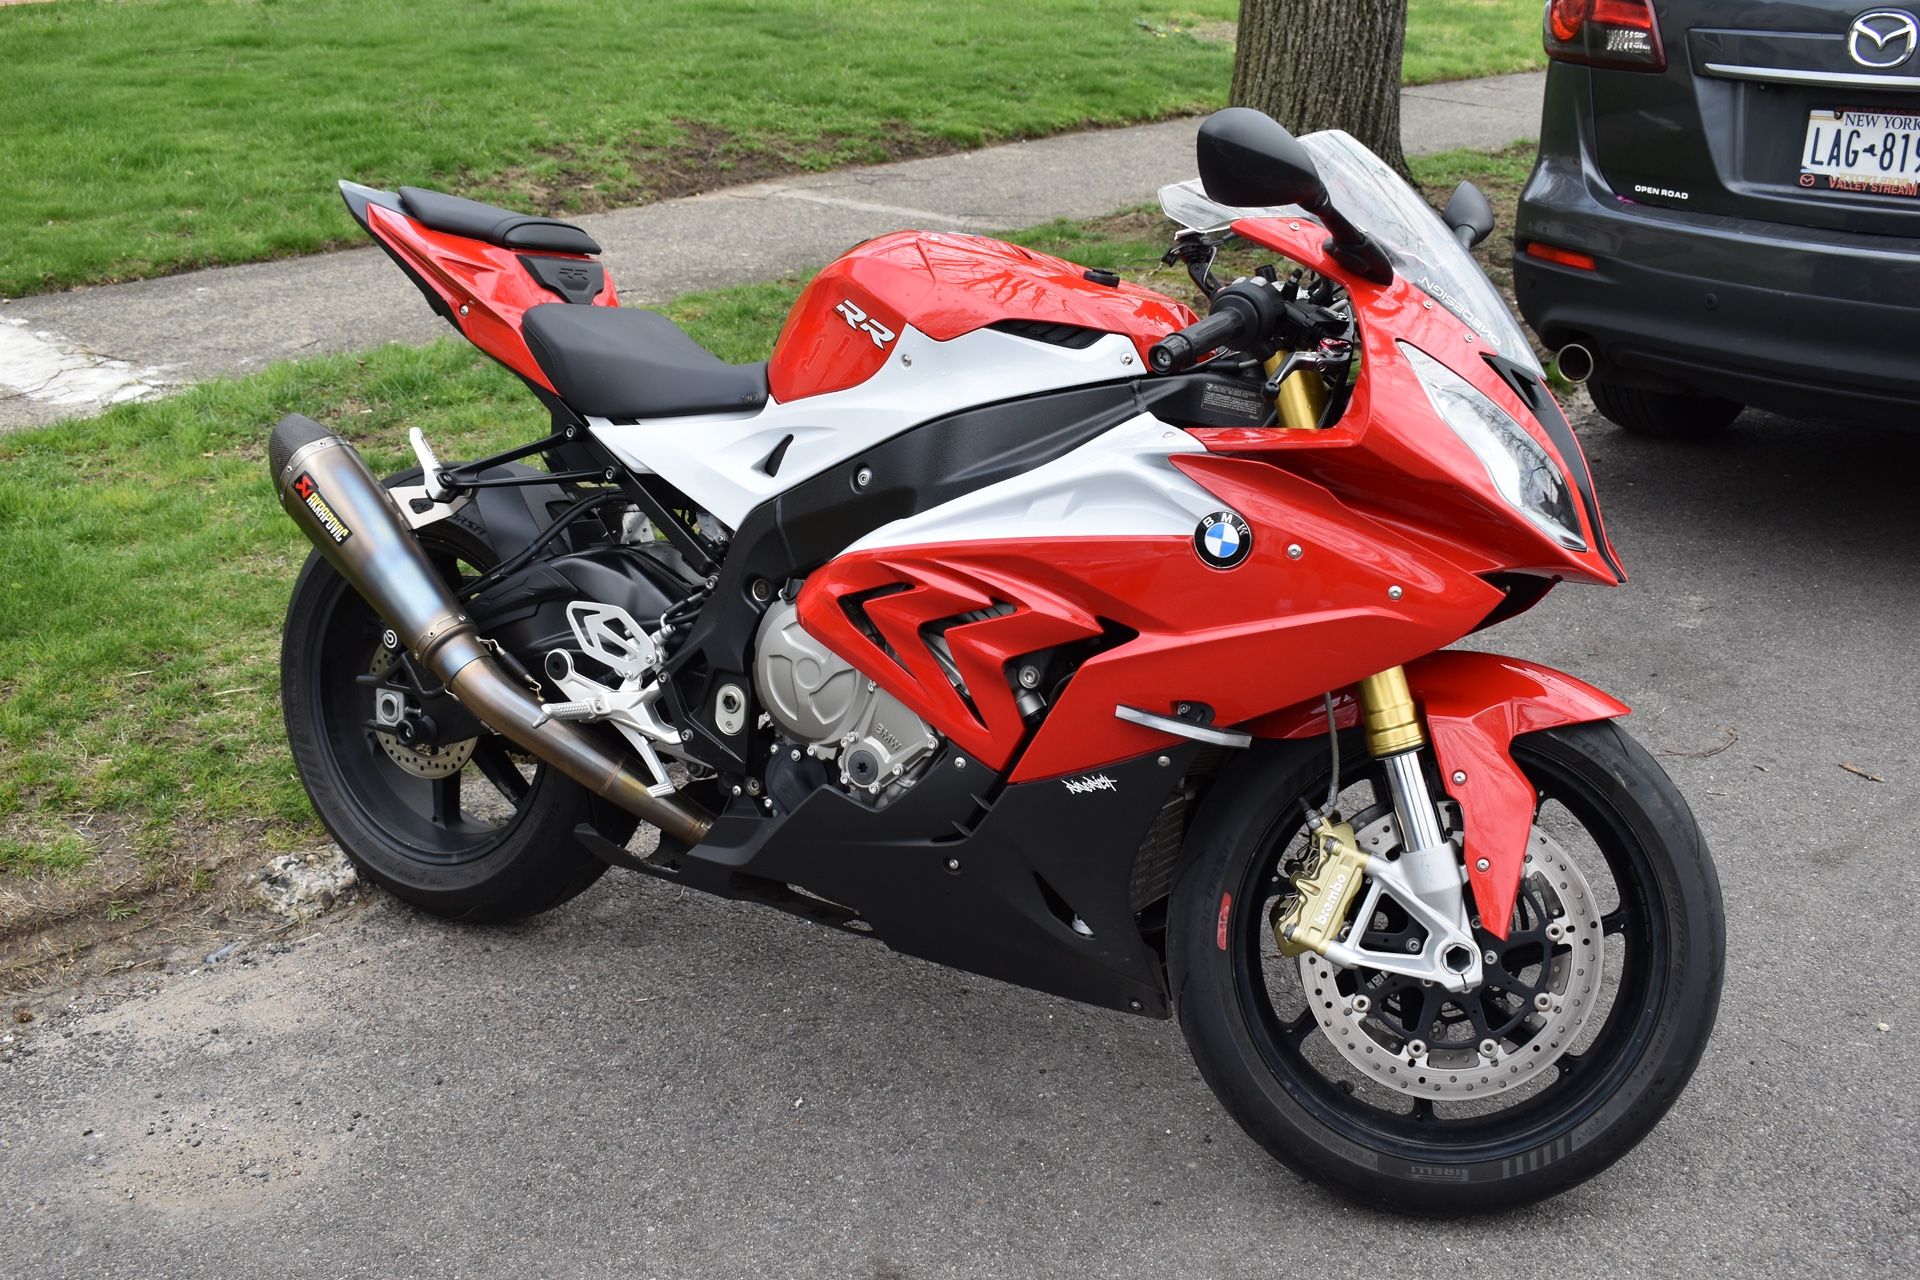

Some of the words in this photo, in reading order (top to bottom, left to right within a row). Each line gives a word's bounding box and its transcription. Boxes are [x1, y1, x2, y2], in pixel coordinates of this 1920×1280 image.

[1844, 113, 1880, 128] NEW
[1634, 184, 1660, 196] OPEN
[1660, 188, 1689, 200] ROAD
[1828, 176, 1870, 191] VALLEY
[1870, 182, 1918, 197] STREAM
[834, 298, 897, 350] RR
[1202, 512, 1249, 537] BMW
[876, 722, 903, 751] BMW
[1313, 873, 1347, 926] brembo
[1410, 1166, 1469, 1182] PIRELLI
